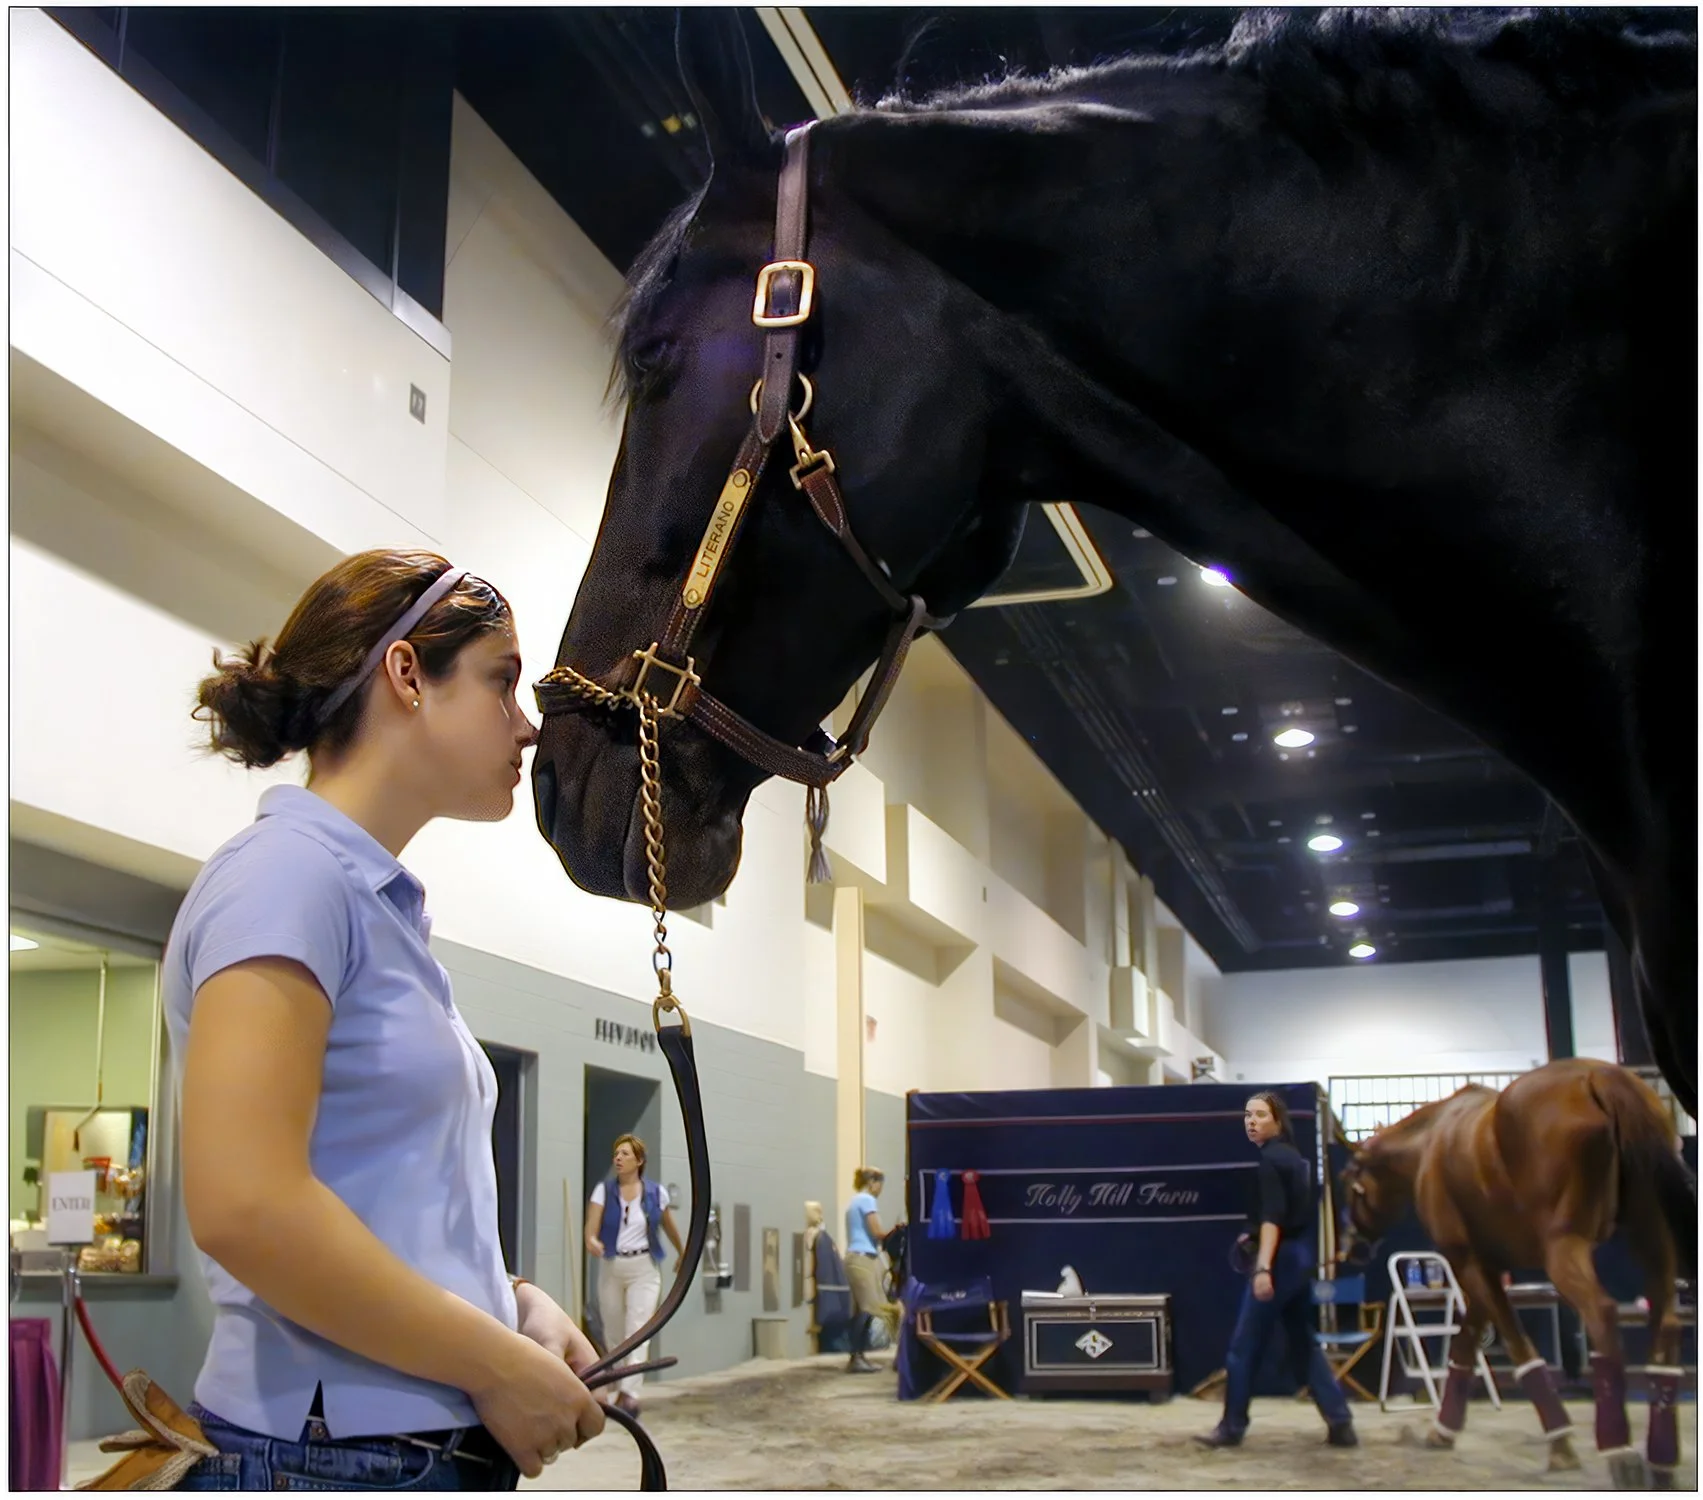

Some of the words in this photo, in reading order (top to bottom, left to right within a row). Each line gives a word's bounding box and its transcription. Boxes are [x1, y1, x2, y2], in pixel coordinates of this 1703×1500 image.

[697, 501, 735, 578] LITERANO
[52, 1197, 91, 1211] ENTER
[1024, 1183, 1083, 1214] Holly
[1088, 1182, 1134, 1206] Hill
[1138, 1182, 1200, 1206] Farm
